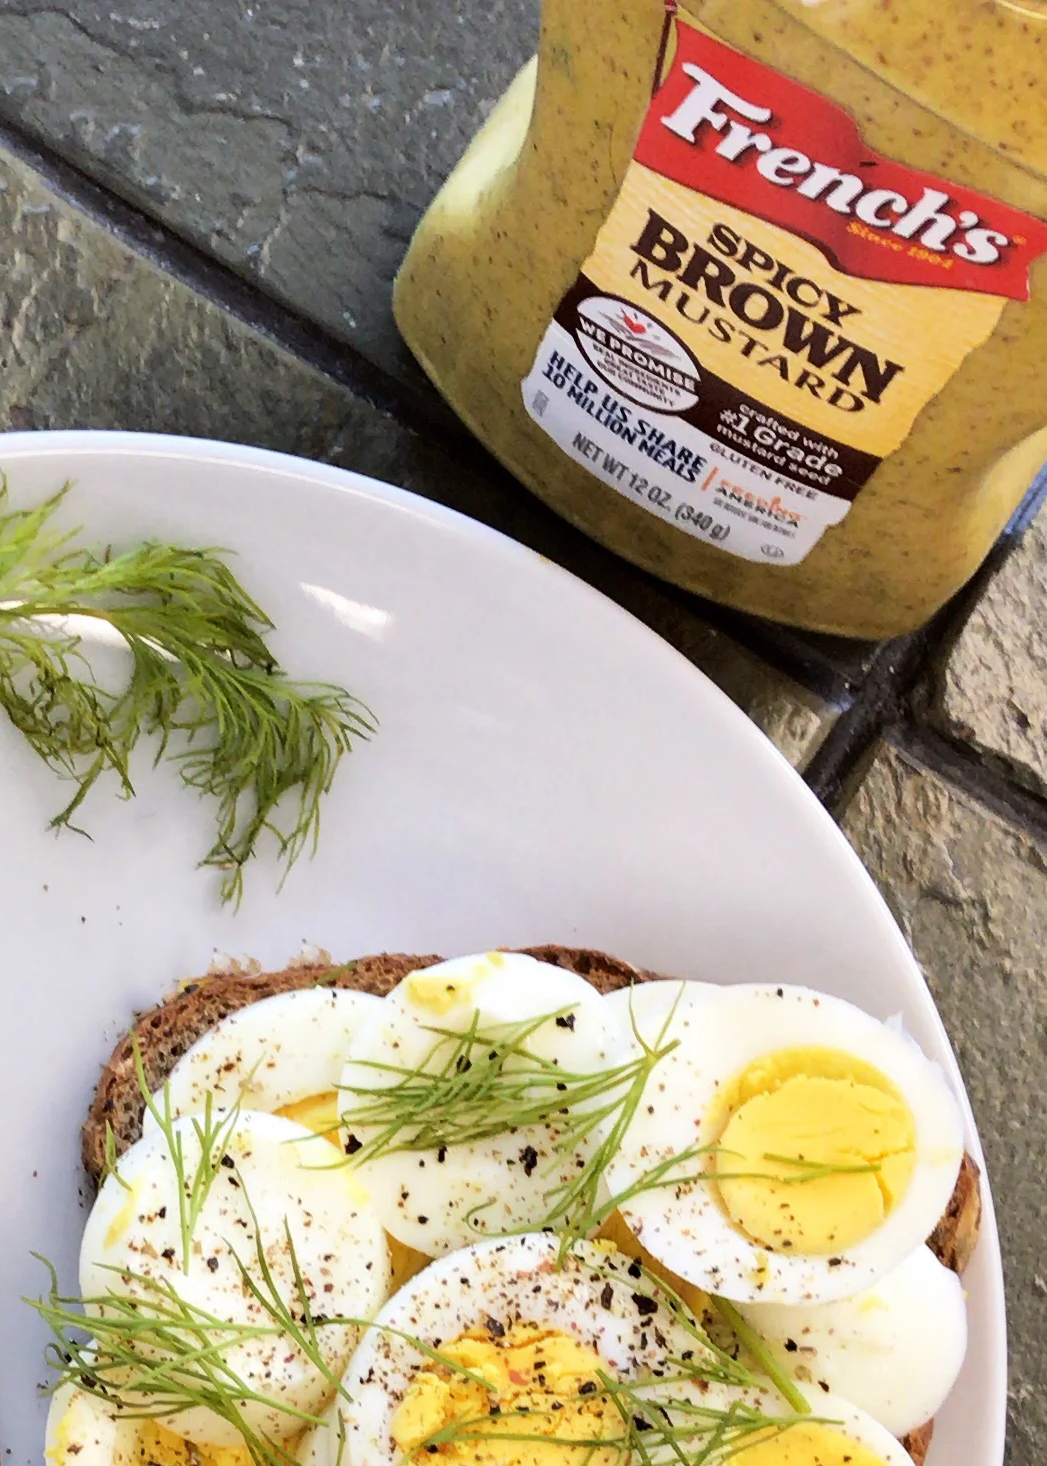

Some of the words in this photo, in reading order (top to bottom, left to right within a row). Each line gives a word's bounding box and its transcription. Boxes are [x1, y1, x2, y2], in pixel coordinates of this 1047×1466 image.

[660, 62, 1009, 265] French's
[629, 208, 905, 404] BROWN
[707, 223, 862, 328] SPICY
[579, 316, 606, 344] WE
[609, 339, 696, 392] PROMISE
[630, 259, 866, 412] MUSTARD
[543, 362, 566, 390] 10
[567, 386, 637, 445] MILLION
[639, 439, 696, 483] MEALS
[550, 350, 598, 395] HELP
[602, 394, 632, 423] US
[635, 419, 708, 475] SHARE
[716, 424, 787, 467] mustard
[788, 462, 832, 486] seed
[719, 409, 750, 436] #1
[754, 426, 843, 477] Grade
[740, 404, 800, 441] crafted
[803, 437, 839, 460] with
[572, 432, 603, 463] NET
[603, 453, 629, 482] WT
[629, 472, 649, 496] 12
[709, 442, 772, 481] GLUTEN
[774, 476, 819, 501] FREE
